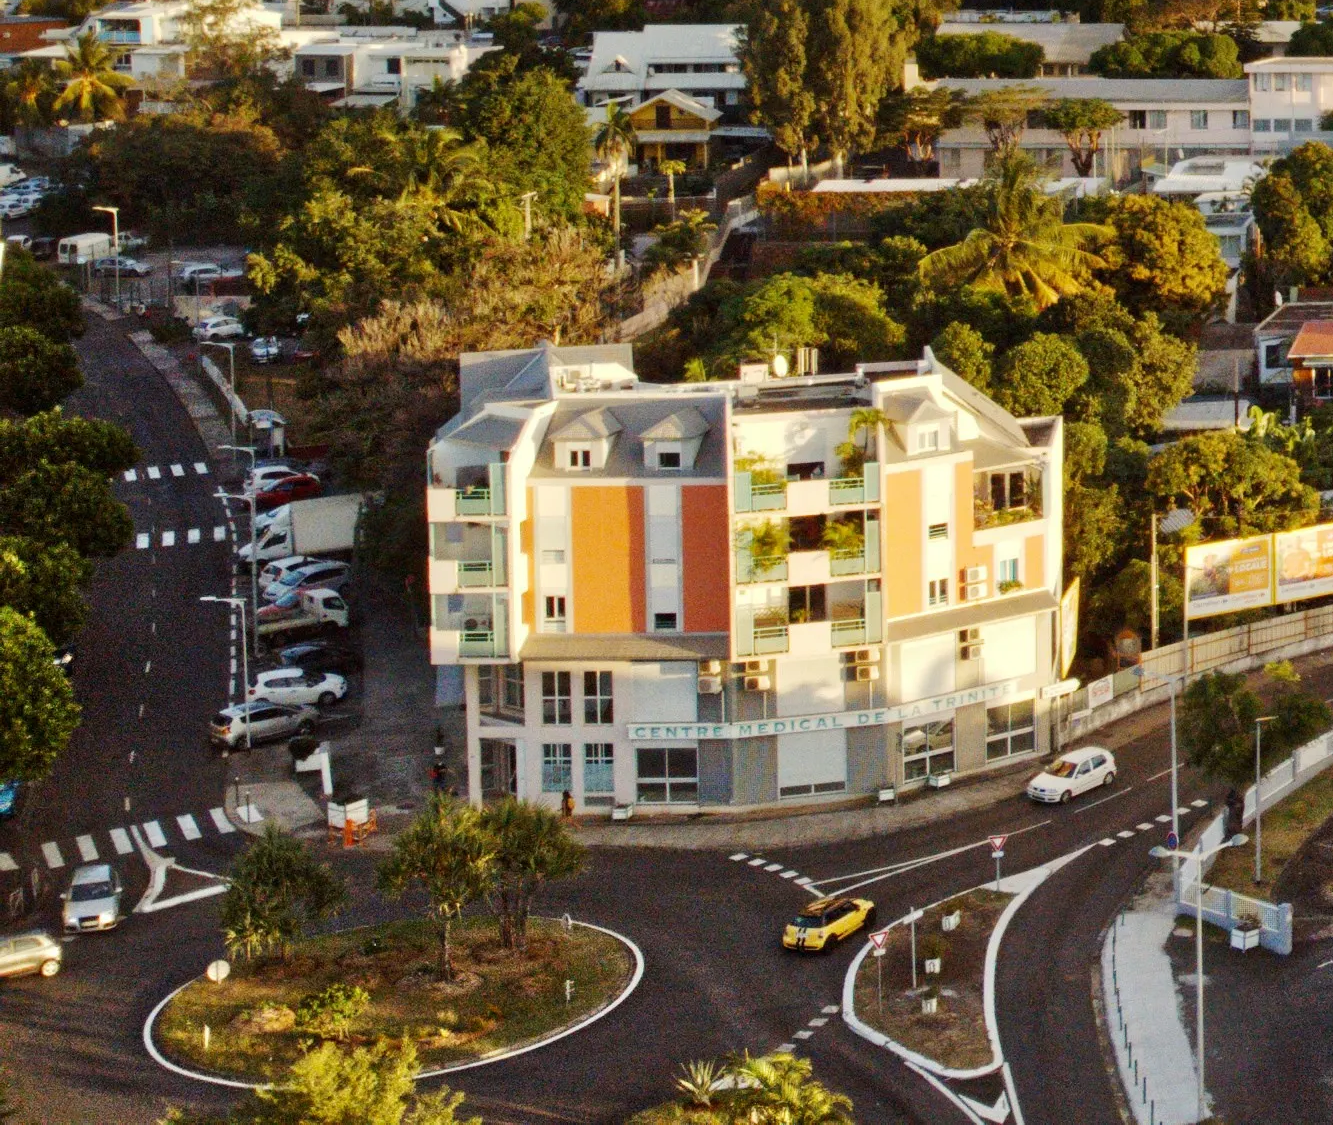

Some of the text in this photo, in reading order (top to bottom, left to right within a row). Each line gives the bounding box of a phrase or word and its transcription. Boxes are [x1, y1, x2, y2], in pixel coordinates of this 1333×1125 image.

[634, 725, 726, 739] CENTRE
[738, 716, 844, 737] MEDICAL
[857, 712, 885, 726] DE
[897, 705, 923, 719] LA
